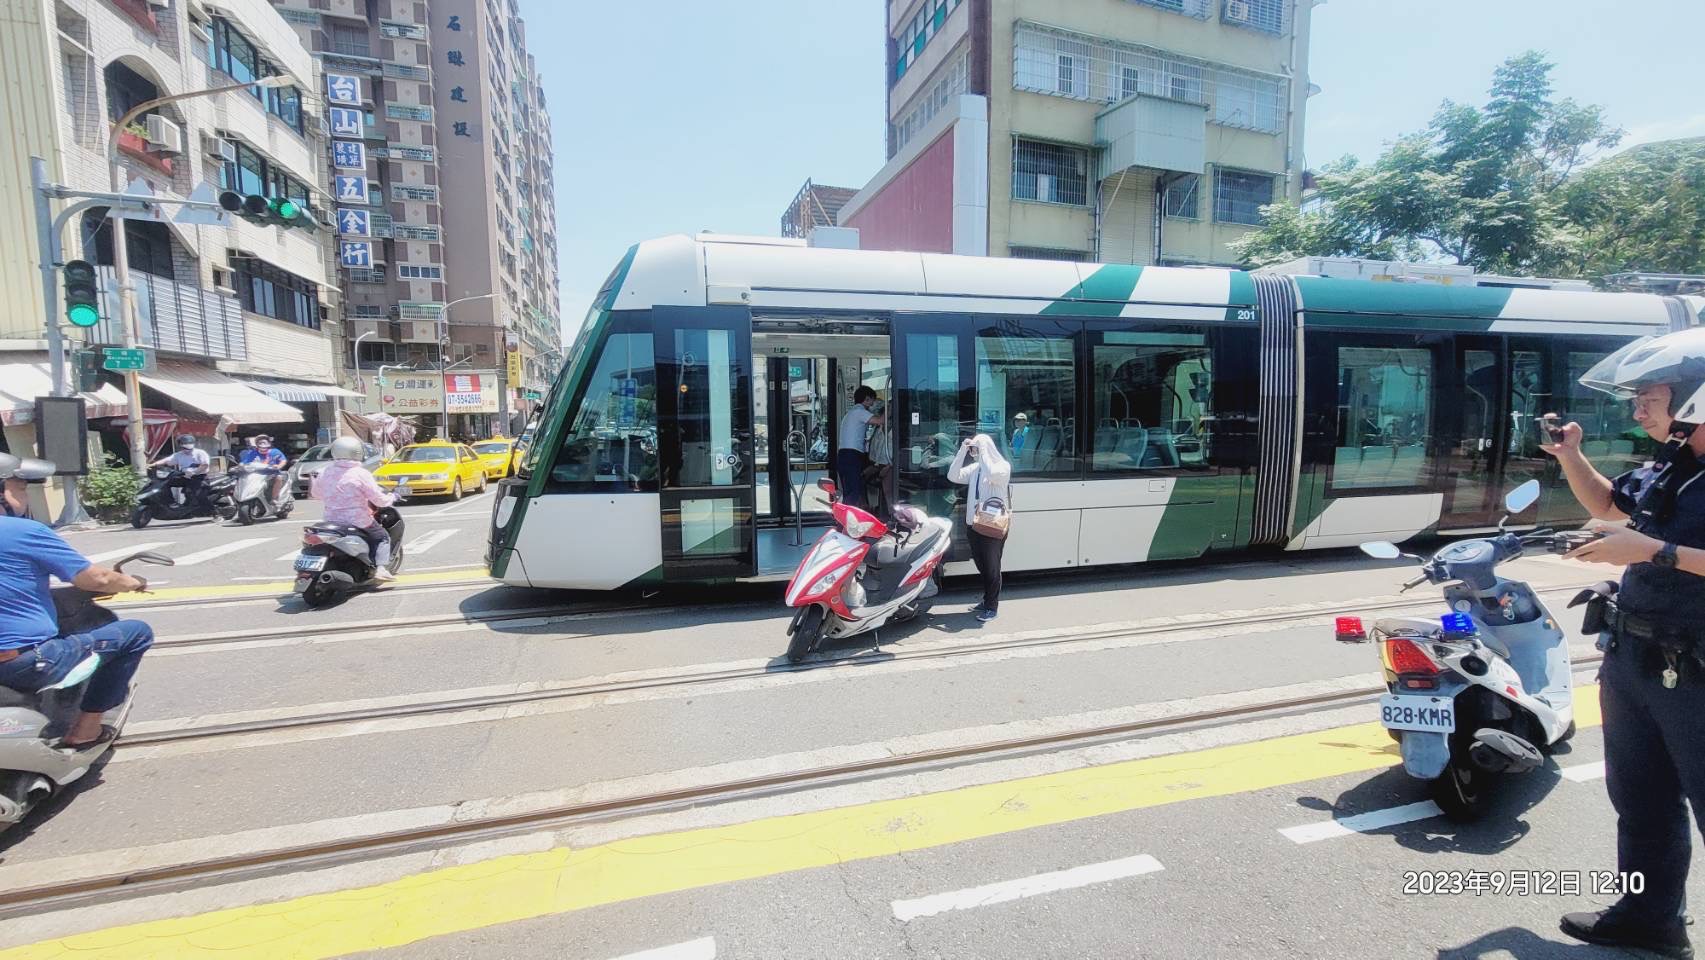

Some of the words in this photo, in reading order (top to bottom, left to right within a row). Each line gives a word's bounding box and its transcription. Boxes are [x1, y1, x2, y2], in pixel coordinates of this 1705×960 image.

[1237, 310, 1255, 320] 201
[398, 397, 439, 408] 公益彩券
[1382, 705, 1453, 727] 828-KMR
